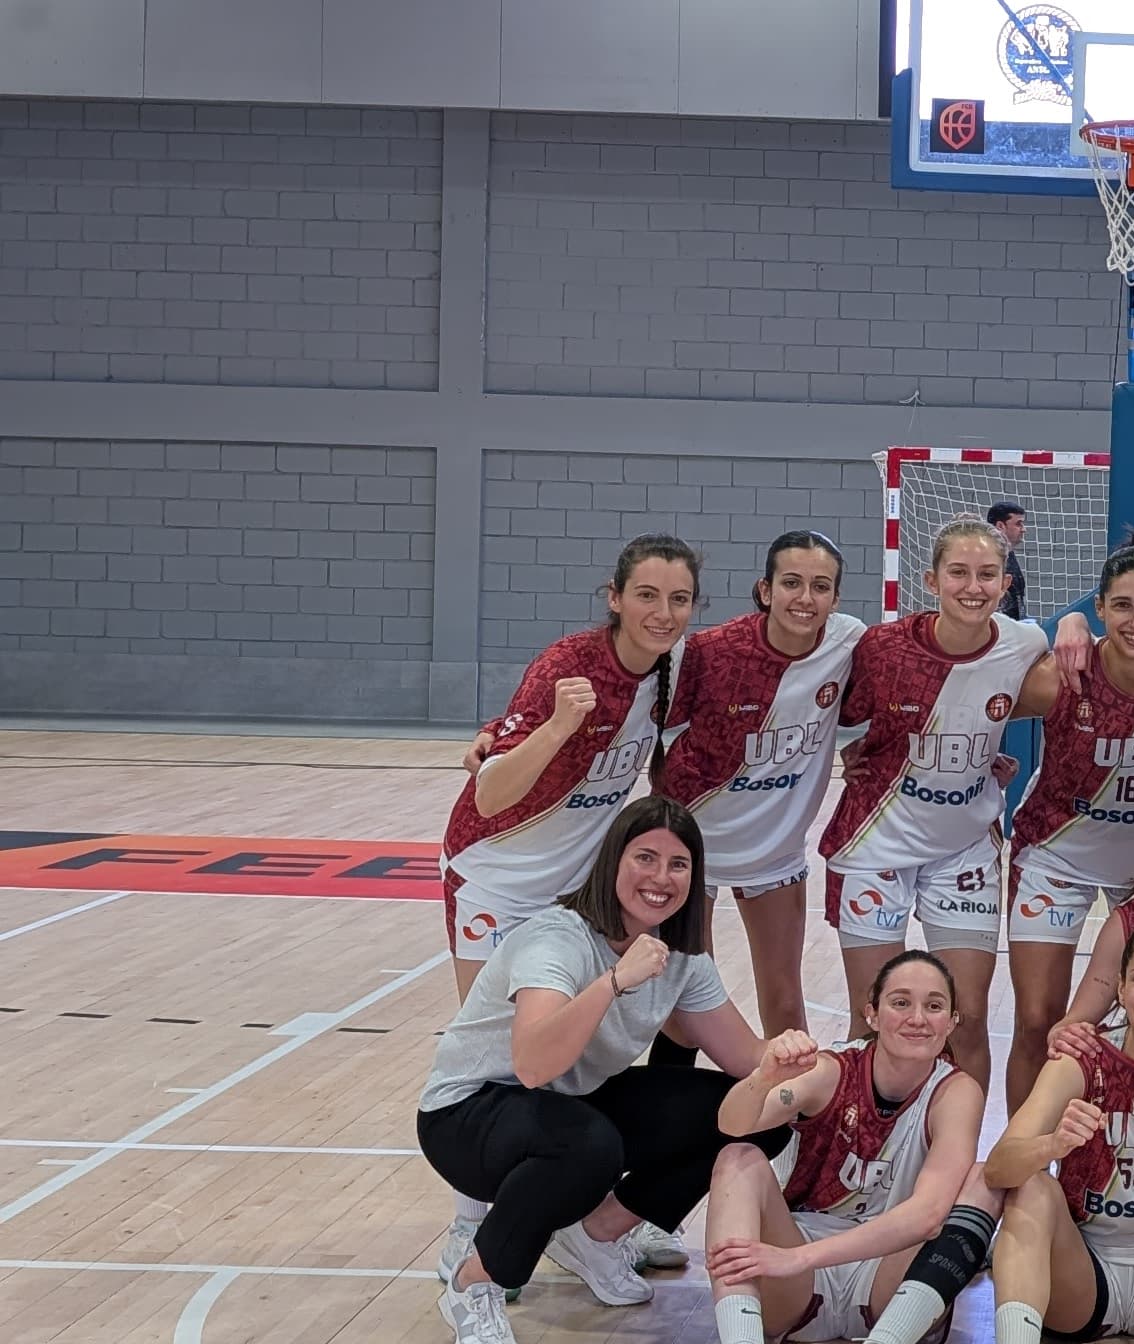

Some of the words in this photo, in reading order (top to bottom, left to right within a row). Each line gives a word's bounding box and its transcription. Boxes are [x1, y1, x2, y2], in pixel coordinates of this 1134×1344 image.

[745, 721, 822, 768] UBL
[907, 732, 990, 774] UBL
[900, 775, 986, 806] Bosonit
[960, 901, 998, 916] RIOJA
[1048, 907, 1075, 927] tvr
